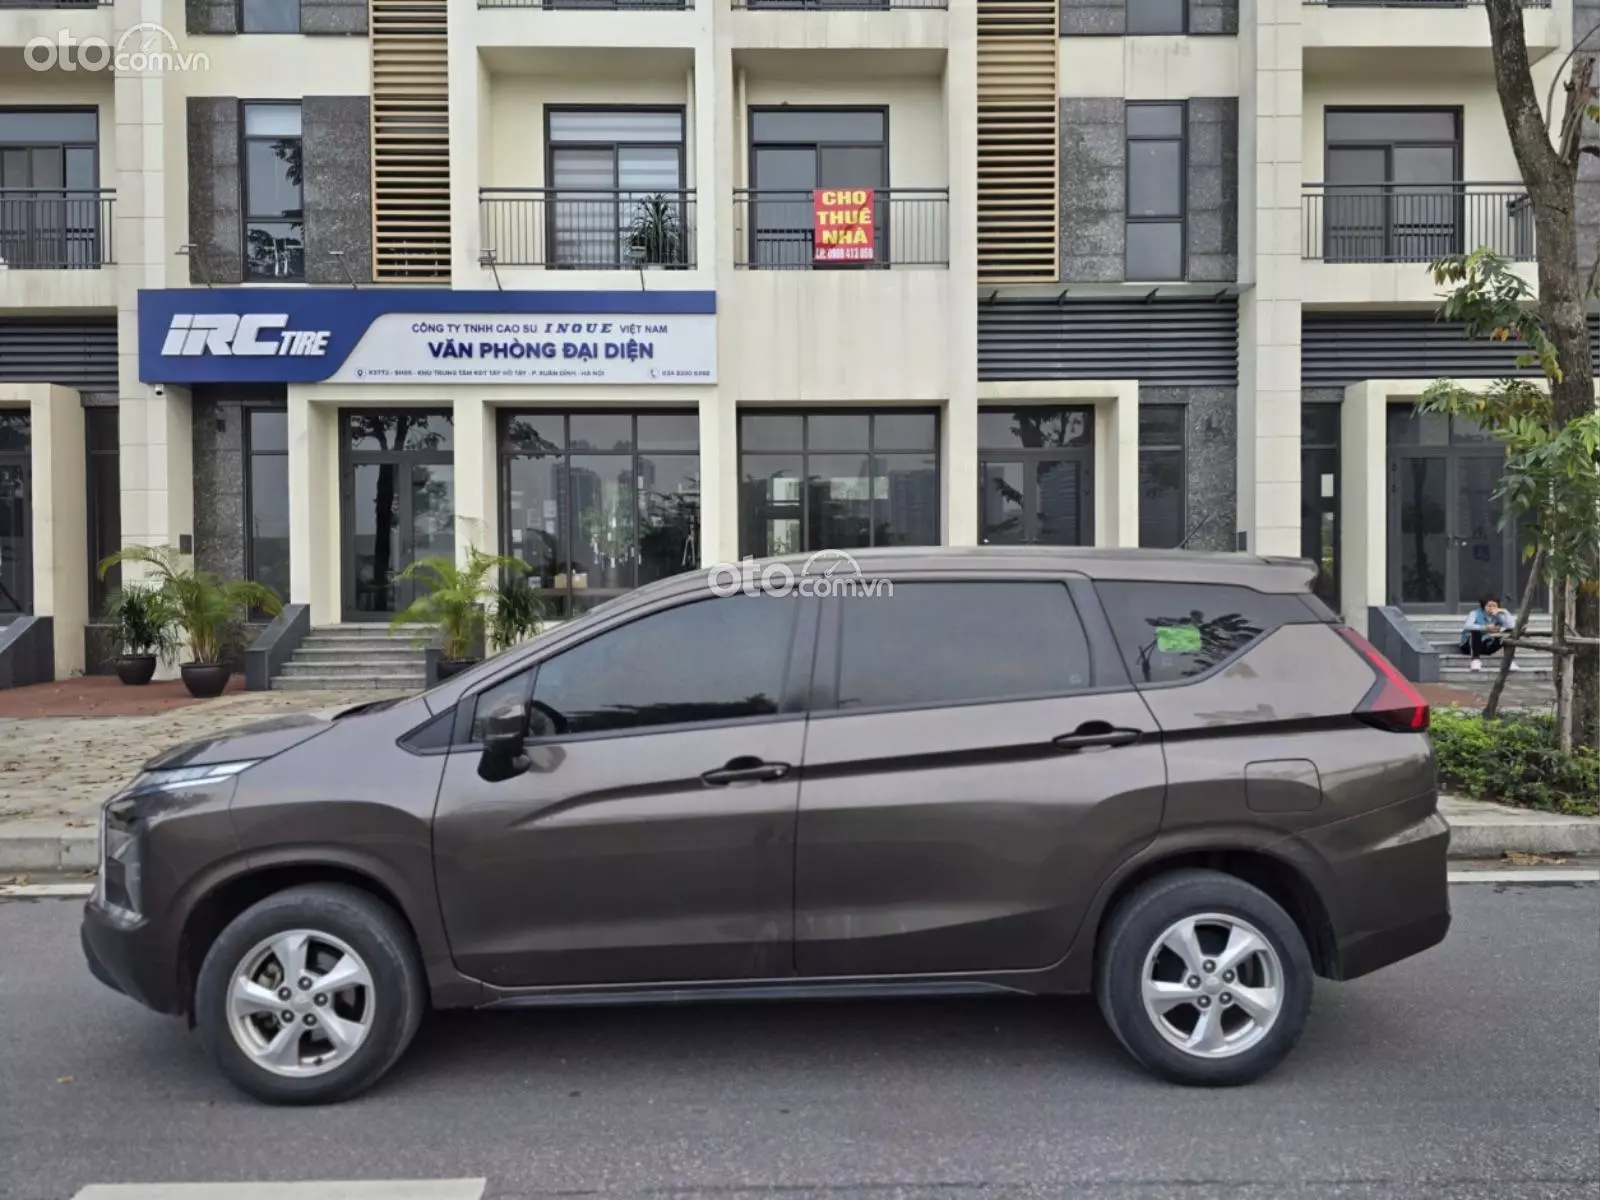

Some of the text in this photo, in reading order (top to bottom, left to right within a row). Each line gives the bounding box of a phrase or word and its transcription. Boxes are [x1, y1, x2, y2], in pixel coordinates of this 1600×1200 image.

[822, 190, 866, 206] CHO
[816, 207, 872, 225] THUÊ
[411, 321, 668, 335] CÔNG TY TNHH CAO SU INOUE VIỆT NAM
[278, 330, 331, 356] TIRE
[427, 337, 654, 362] VĂN PHÒNG ĐẠI DIỆN
